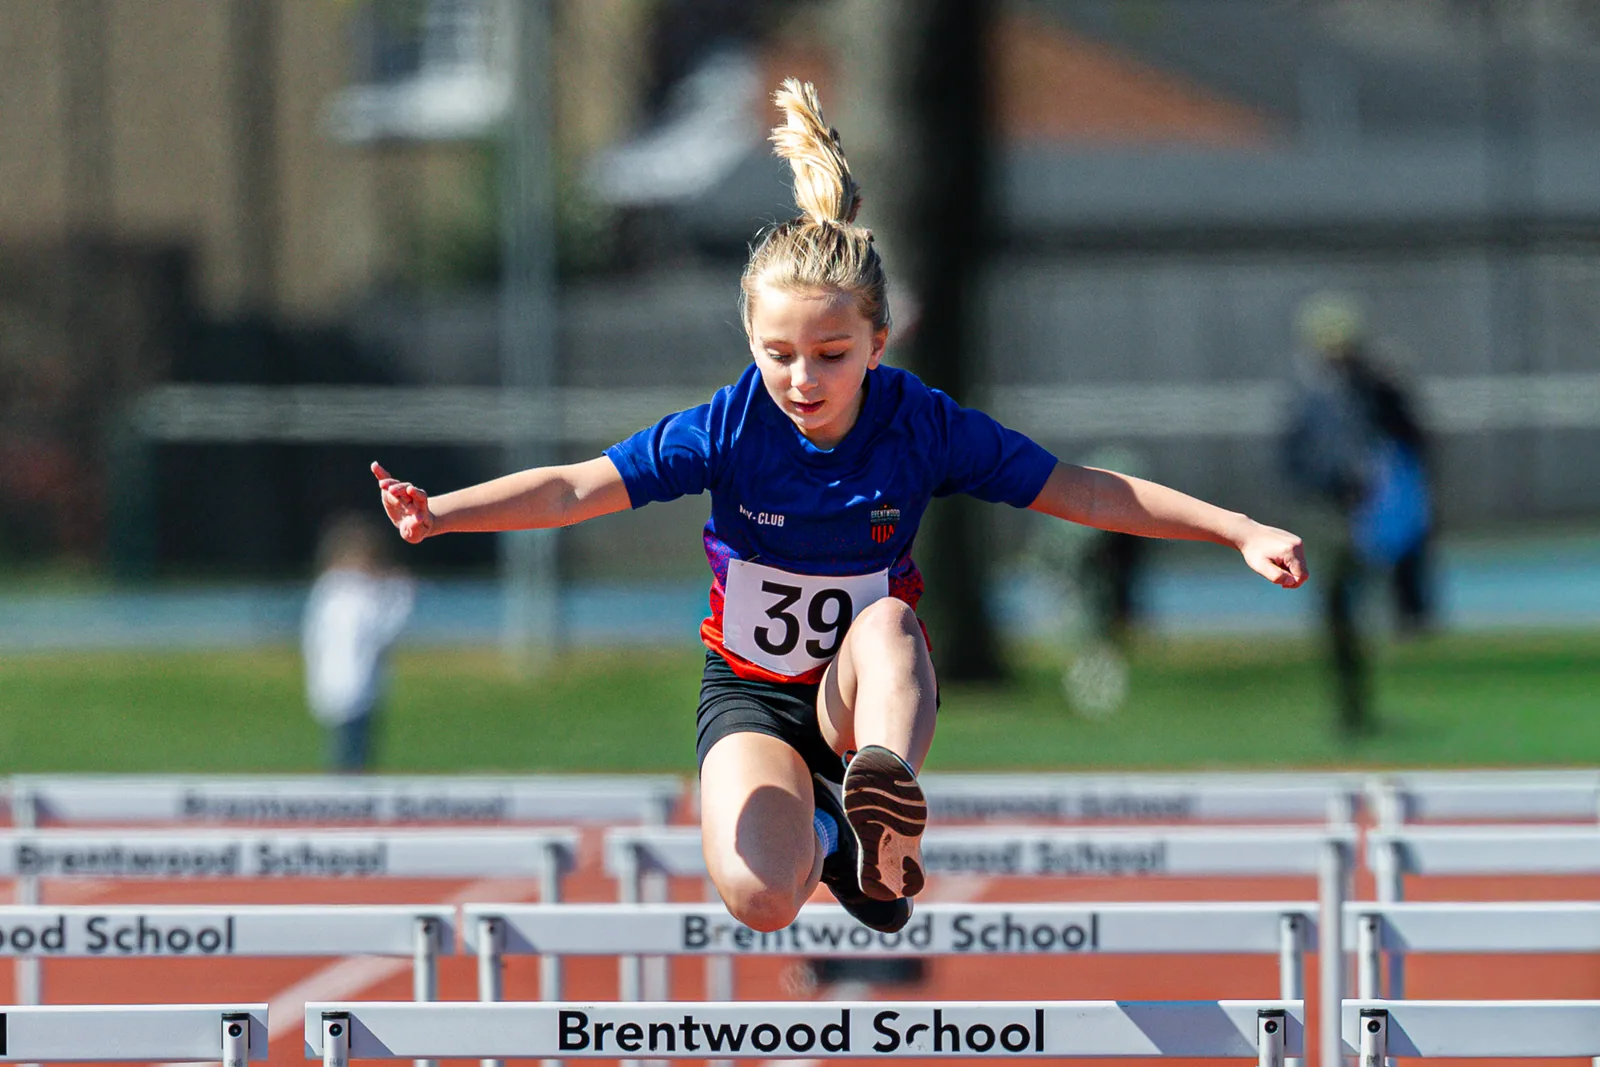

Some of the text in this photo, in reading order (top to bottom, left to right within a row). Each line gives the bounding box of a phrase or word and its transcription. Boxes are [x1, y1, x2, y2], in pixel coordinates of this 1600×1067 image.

[753, 579, 853, 659] 39
[15, 840, 388, 876] Brentwood School
[1037, 839, 1167, 875] School
[85, 915, 235, 953] School
[951, 914, 1100, 951] School
[558, 1009, 1045, 1052] Brentwood School
